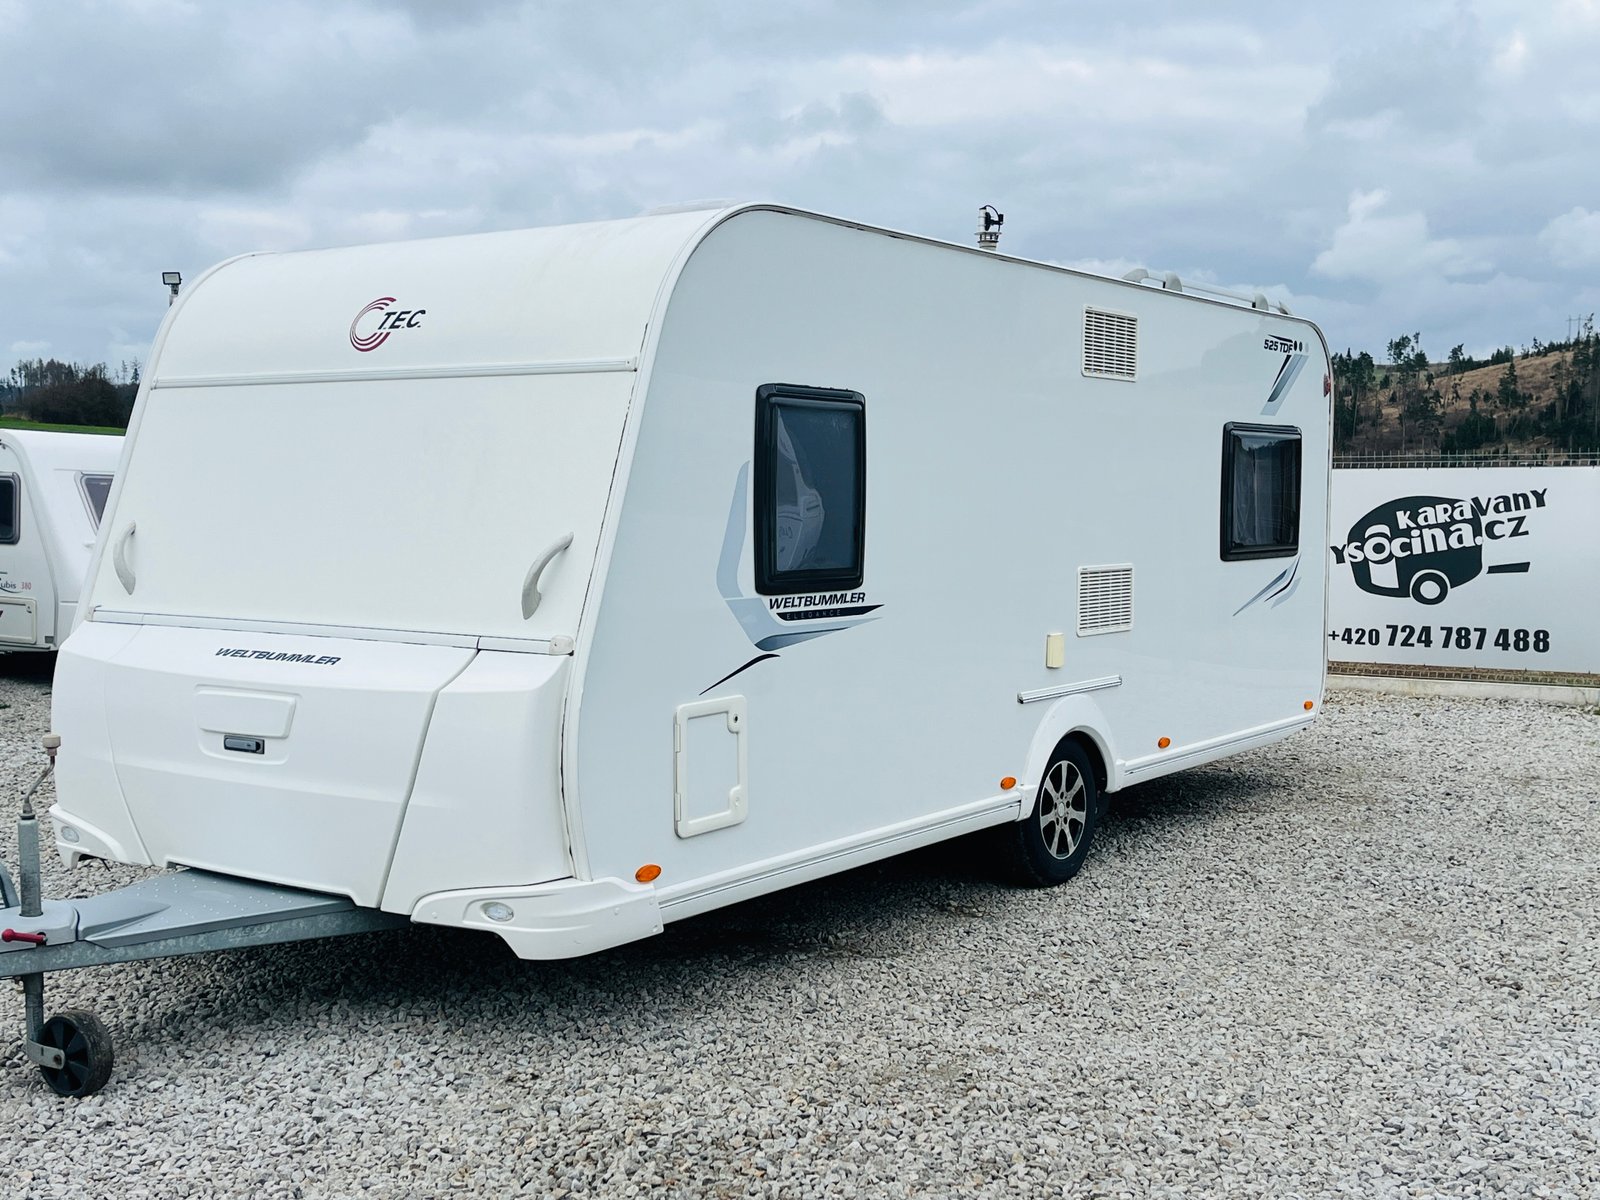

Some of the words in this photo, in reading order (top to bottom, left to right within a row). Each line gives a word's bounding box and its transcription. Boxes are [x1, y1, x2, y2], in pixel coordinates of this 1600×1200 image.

[1263, 339, 1279, 351] 525
[1279, 342, 1293, 353] TDF
[769, 592, 866, 610] WELTBUMMLER
[786, 609, 841, 620] ELEGANCE
[1328, 627, 1380, 645] +420
[1386, 624, 1433, 647] 724
[1440, 626, 1487, 650] 787
[1494, 628, 1550, 653] 488
[215, 647, 342, 666] WELTBUMMLER
